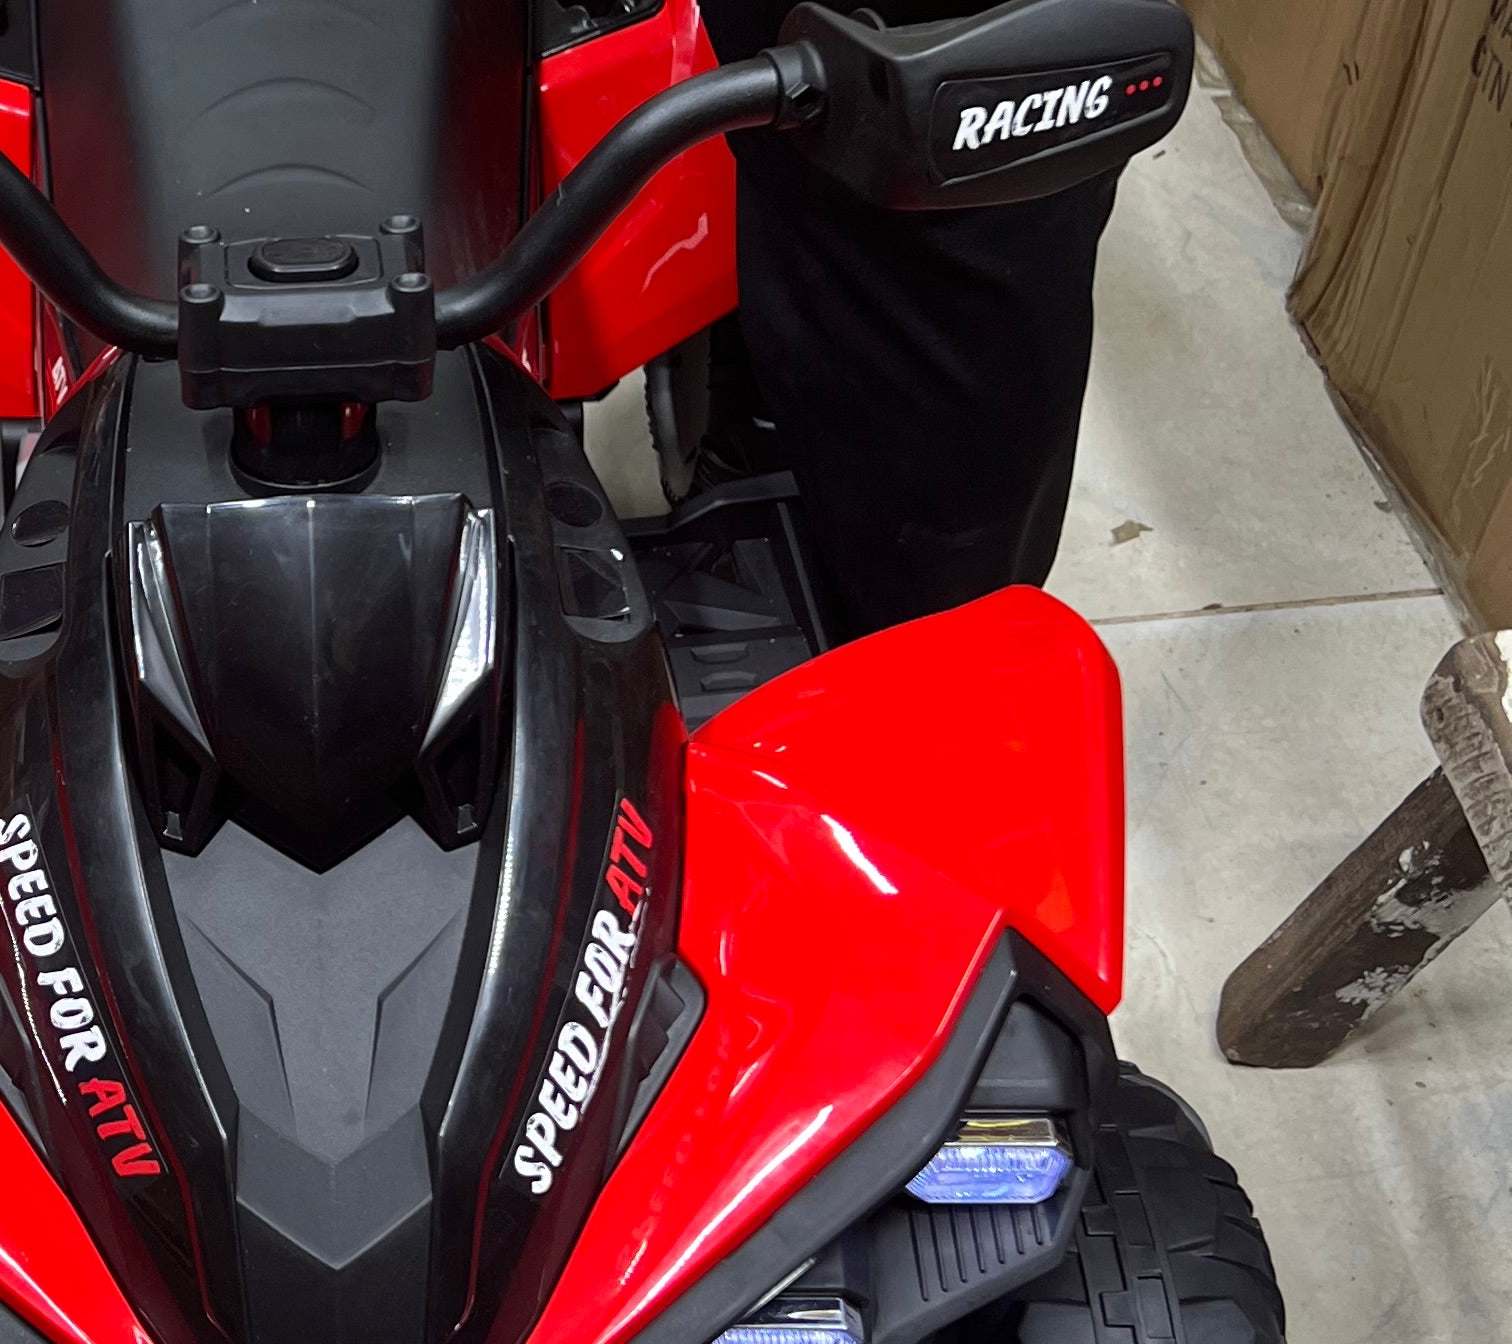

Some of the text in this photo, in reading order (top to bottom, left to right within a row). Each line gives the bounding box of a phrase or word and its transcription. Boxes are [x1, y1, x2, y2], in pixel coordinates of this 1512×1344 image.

[951, 74, 1113, 151] RACING
[36, 967, 107, 1073] FOR
[78, 1077, 162, 1178] ATV
[514, 796, 655, 1194] SPEED FOR ATV
